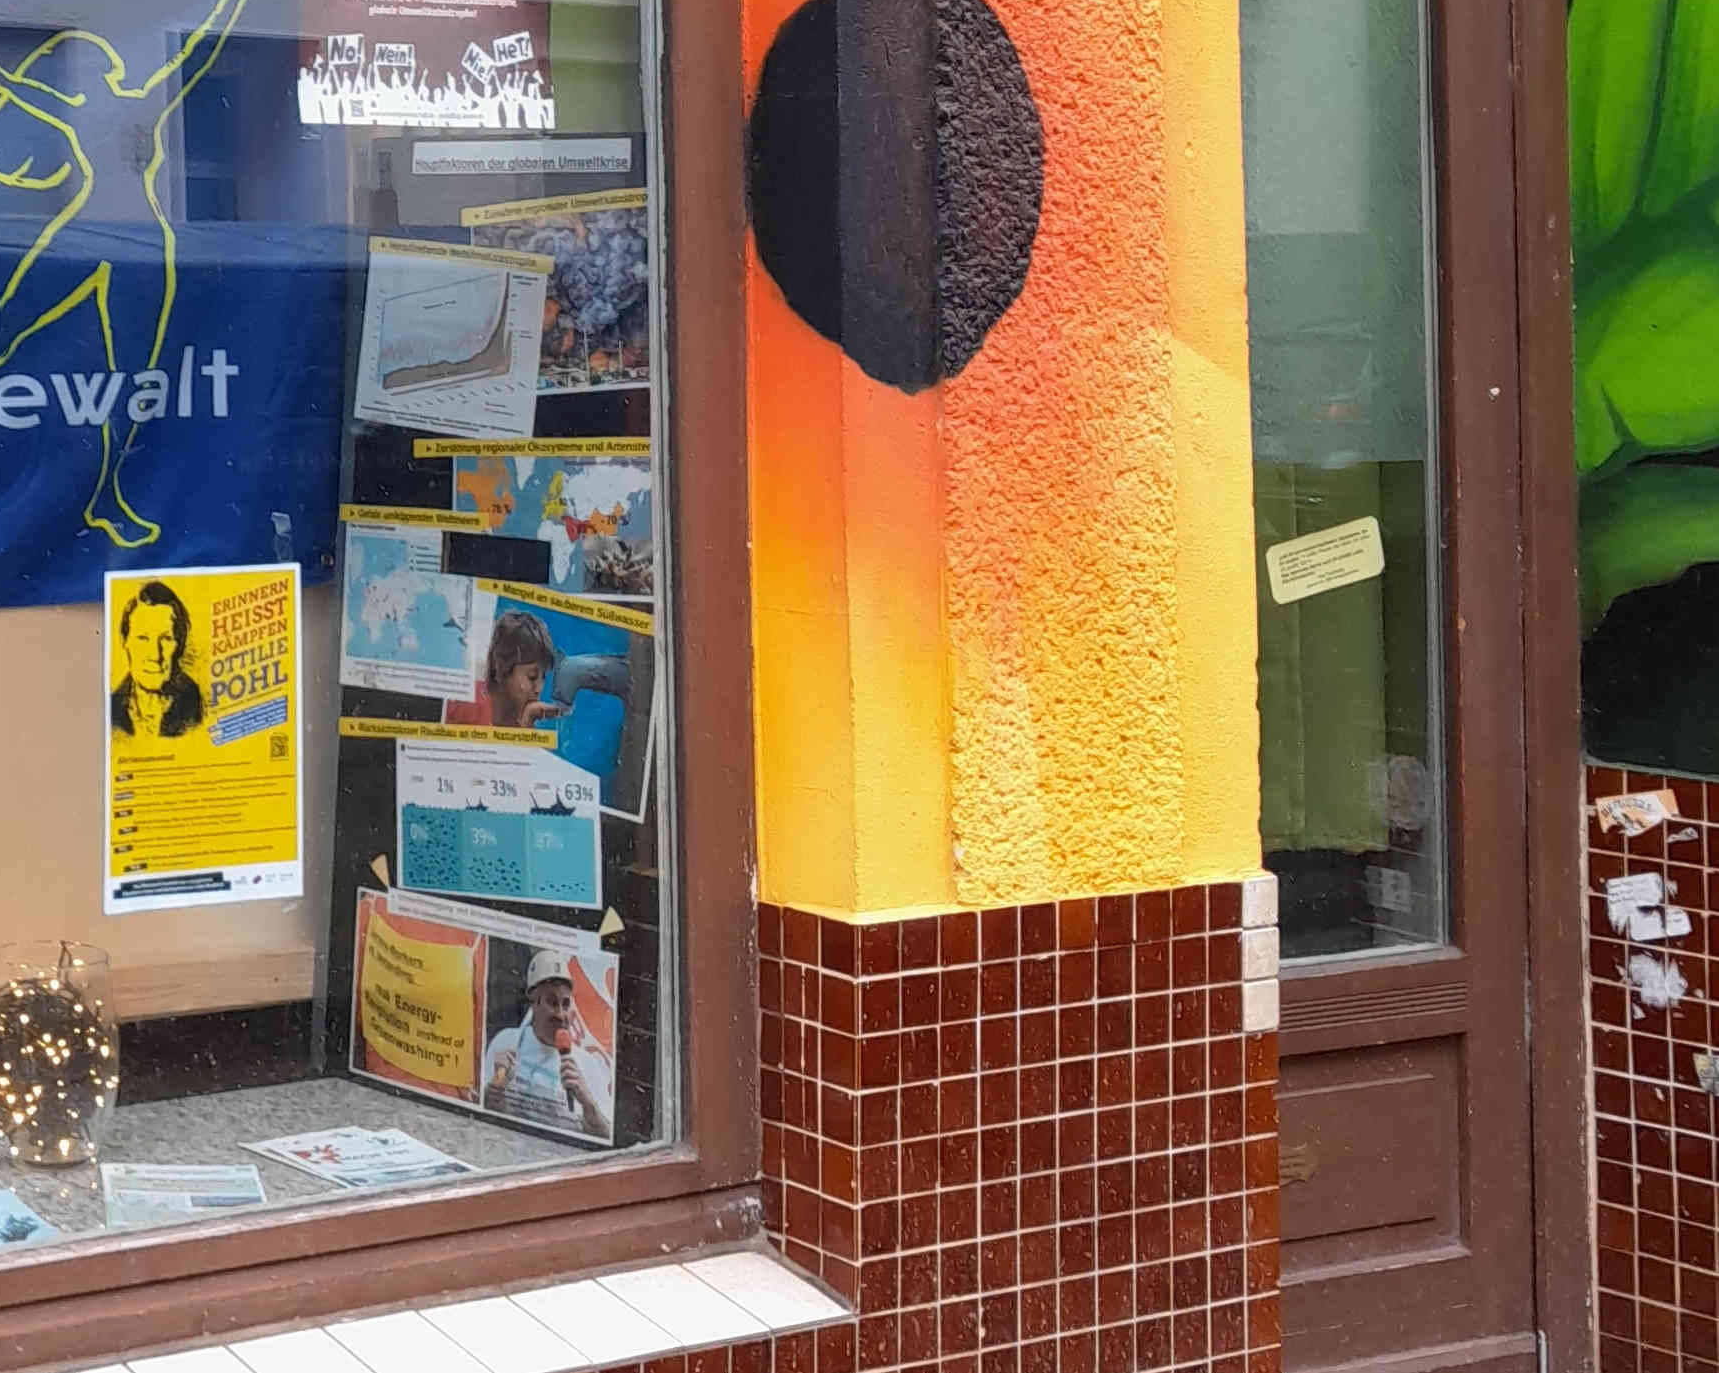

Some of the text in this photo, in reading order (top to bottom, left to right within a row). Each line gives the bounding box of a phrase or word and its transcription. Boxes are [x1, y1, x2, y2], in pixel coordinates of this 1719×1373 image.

[330, 35, 363, 61] No!
[376, 46, 413, 64] Nein!
[507, 156, 555, 170] globalen
[557, 156, 629, 169] Umweltkrise
[585, 442, 604, 453] und
[212, 579, 289, 616] ERINNERN
[211, 596, 288, 639] HEISST
[210, 636, 289, 678] OTTILIE
[210, 661, 289, 707] POHL
[489, 779, 518, 797] 33%
[564, 783, 594, 802] 63%
